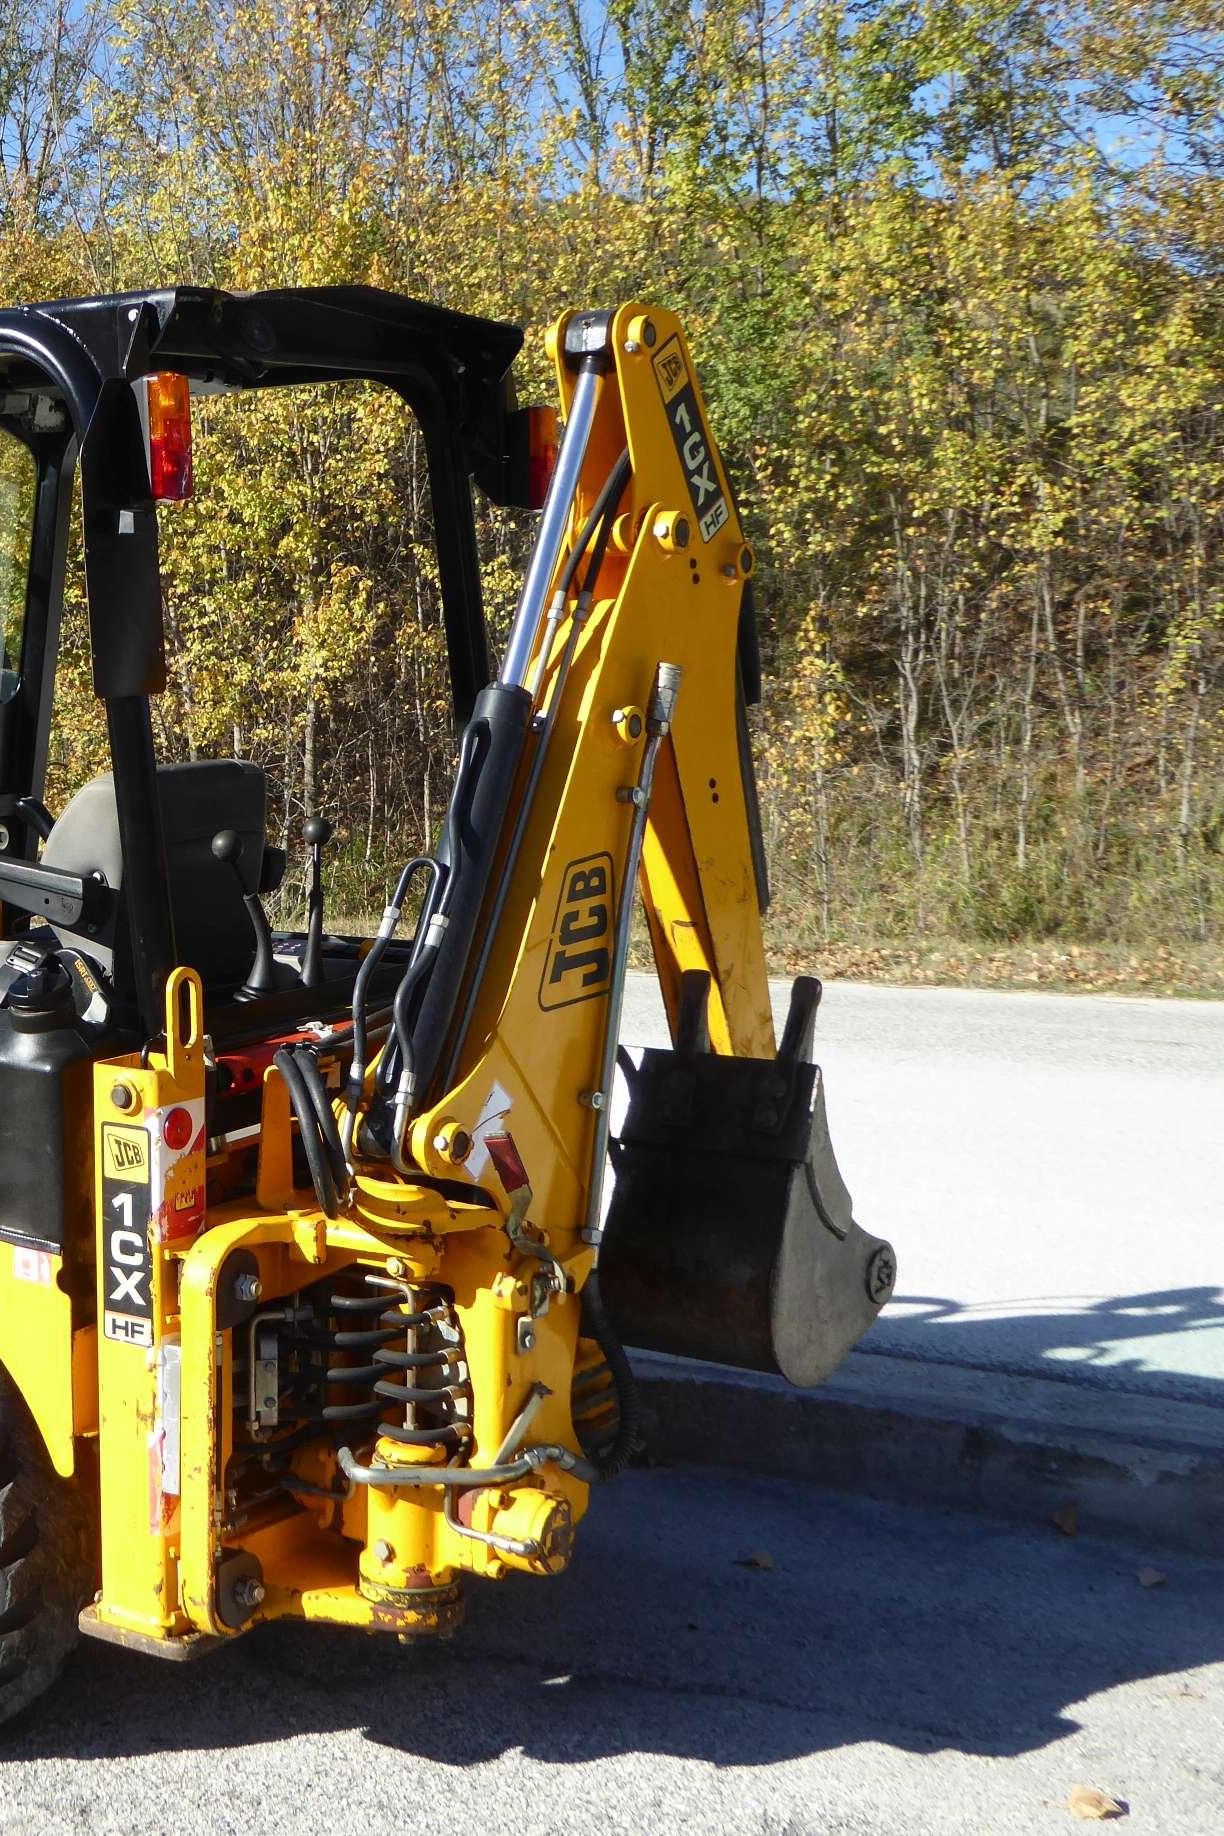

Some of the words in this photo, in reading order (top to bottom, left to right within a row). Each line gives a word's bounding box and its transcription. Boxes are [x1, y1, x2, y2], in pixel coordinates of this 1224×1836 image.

[674, 402, 717, 507] 1CX
[703, 504, 724, 537] HF
[549, 866, 610, 988] JCB
[114, 1138, 143, 1167] JCB
[109, 1192, 147, 1306] 1CX
[111, 1318, 145, 1339] HF
